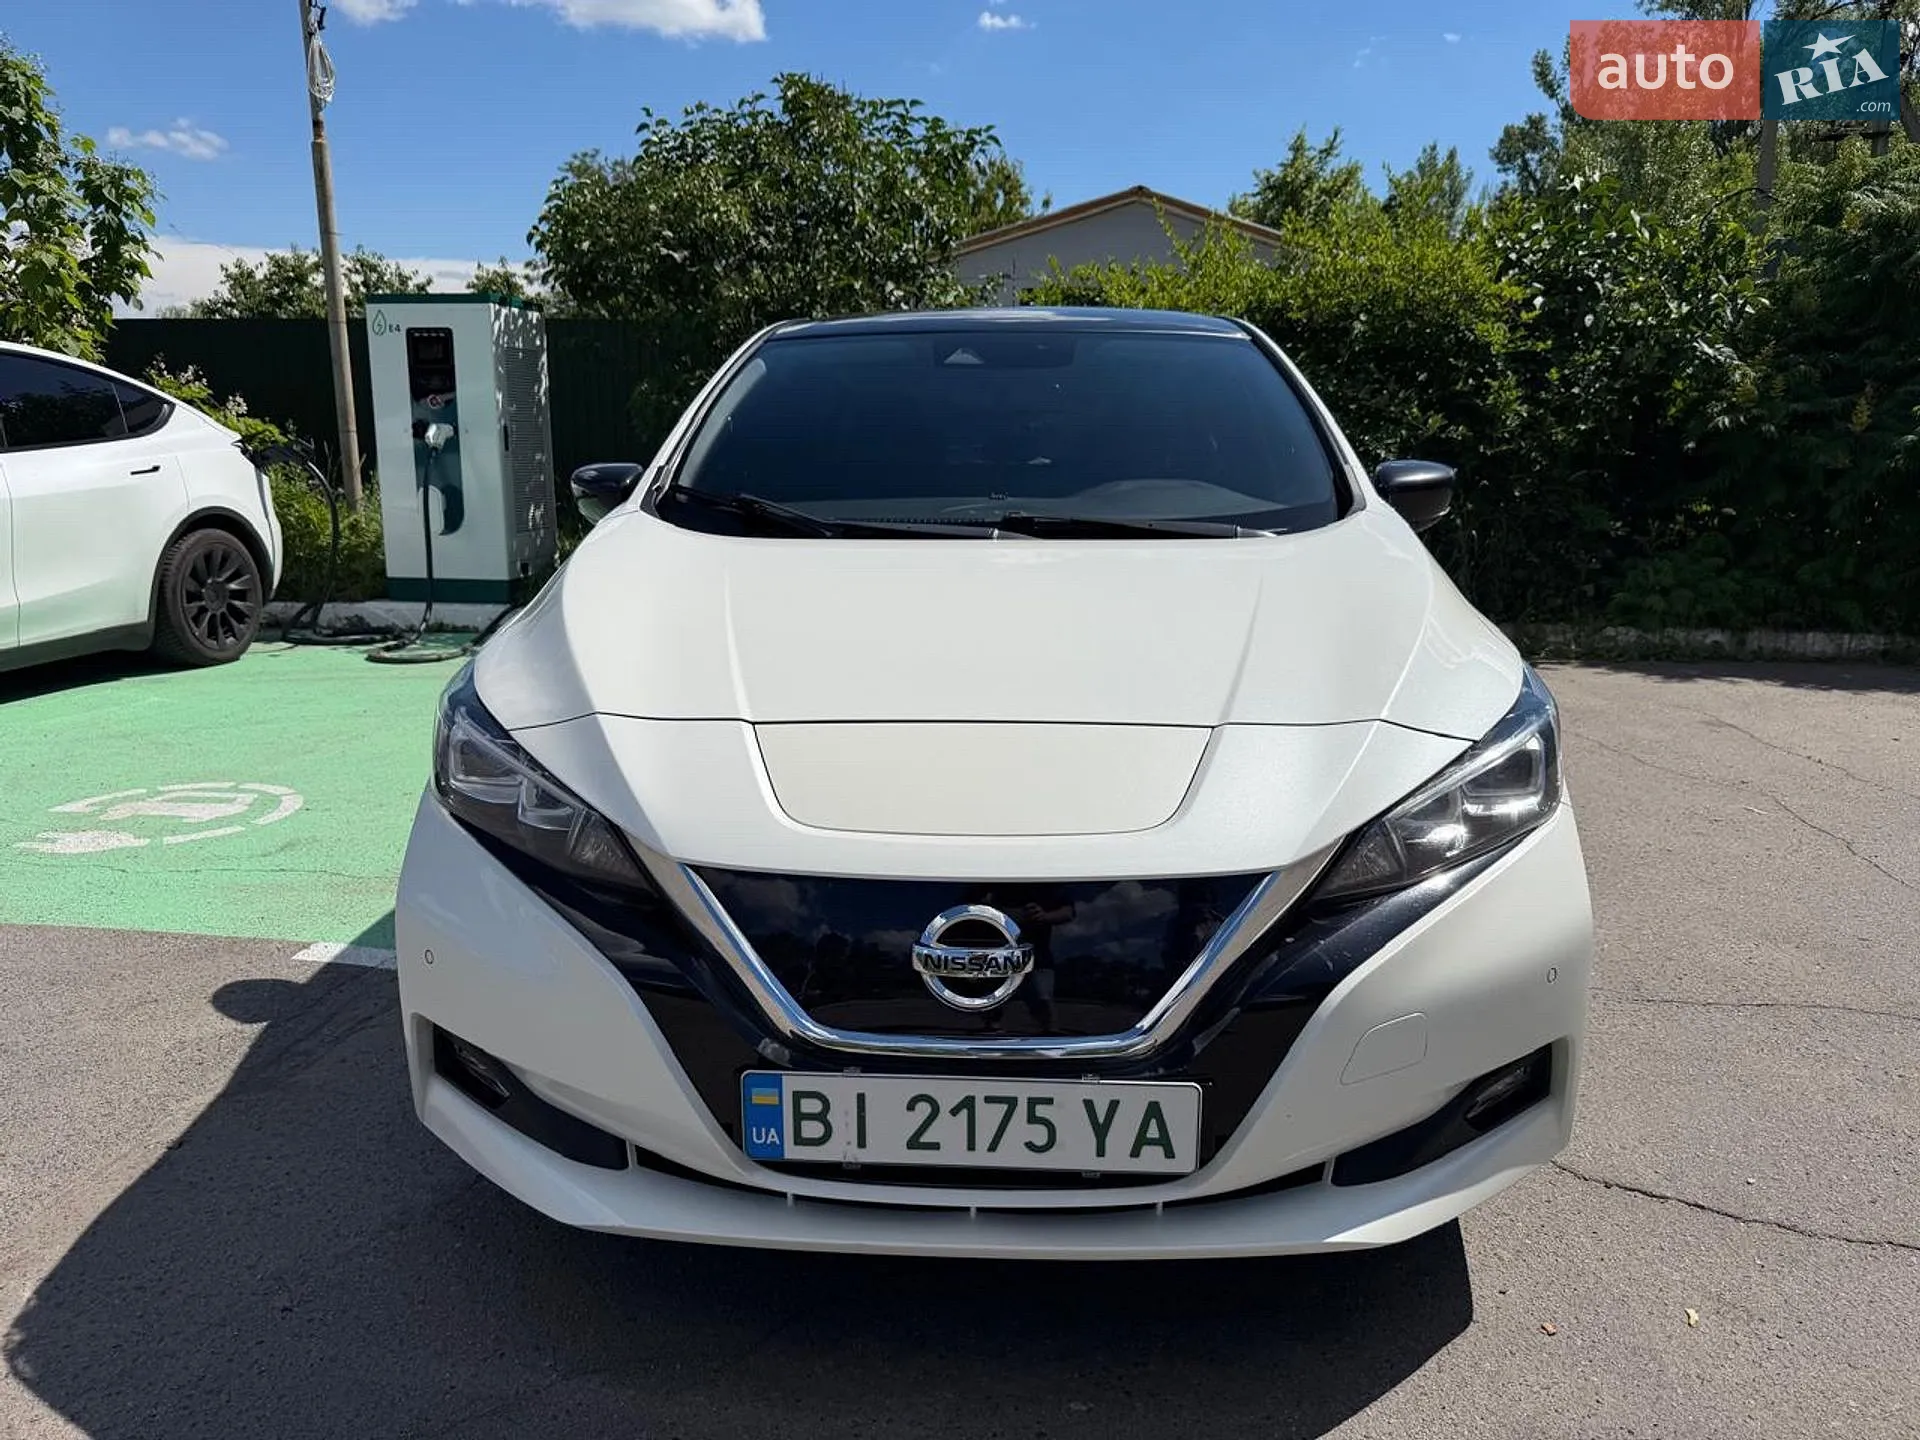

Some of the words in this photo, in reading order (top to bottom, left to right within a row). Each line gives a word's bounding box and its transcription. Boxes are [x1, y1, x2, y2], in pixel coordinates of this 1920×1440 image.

[922, 952, 1020, 973] NISSAN
[792, 1090, 867, 1149] BI
[905, 1094, 1058, 1154] 2175
[1083, 1098, 1176, 1159] YA
[752, 1127, 780, 1145] UA
